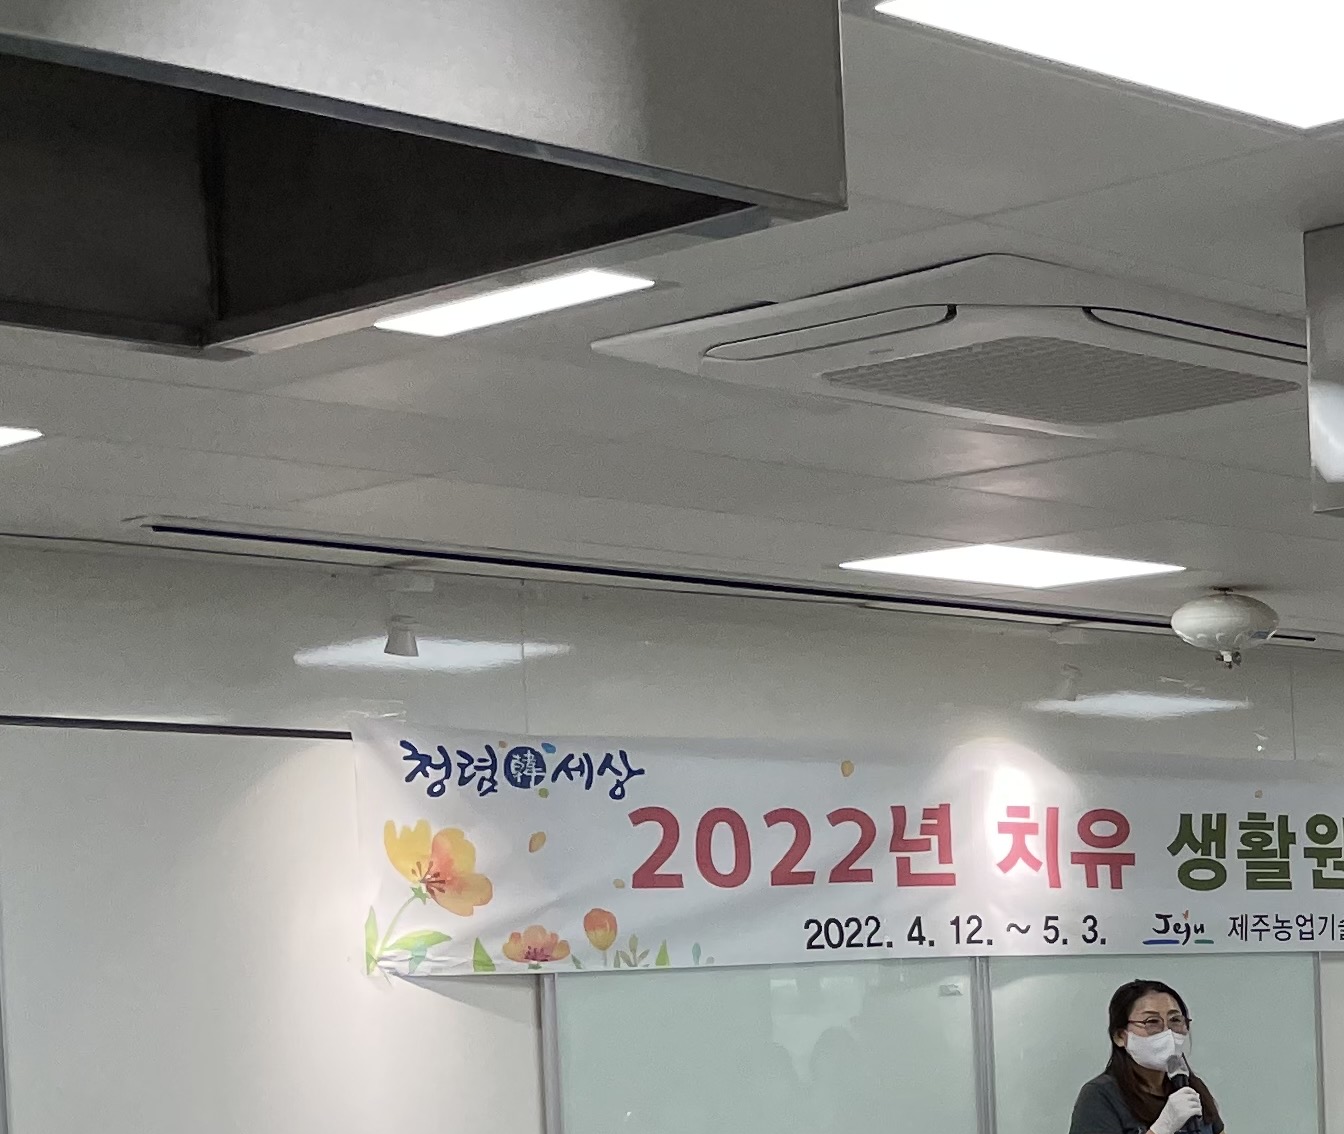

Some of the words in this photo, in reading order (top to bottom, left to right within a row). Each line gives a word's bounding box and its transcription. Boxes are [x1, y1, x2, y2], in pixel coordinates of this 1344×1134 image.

[627, 804, 956, 889] 2022년
[996, 806, 1137, 890] 치유
[803, 915, 893, 949] 2022.
[907, 916, 935, 947] 4.
[950, 915, 993, 946] 12.
[1043, 915, 1068, 945] 5.
[1081, 915, 1106, 945] 3.
[1152, 912, 1205, 946] Jeju
